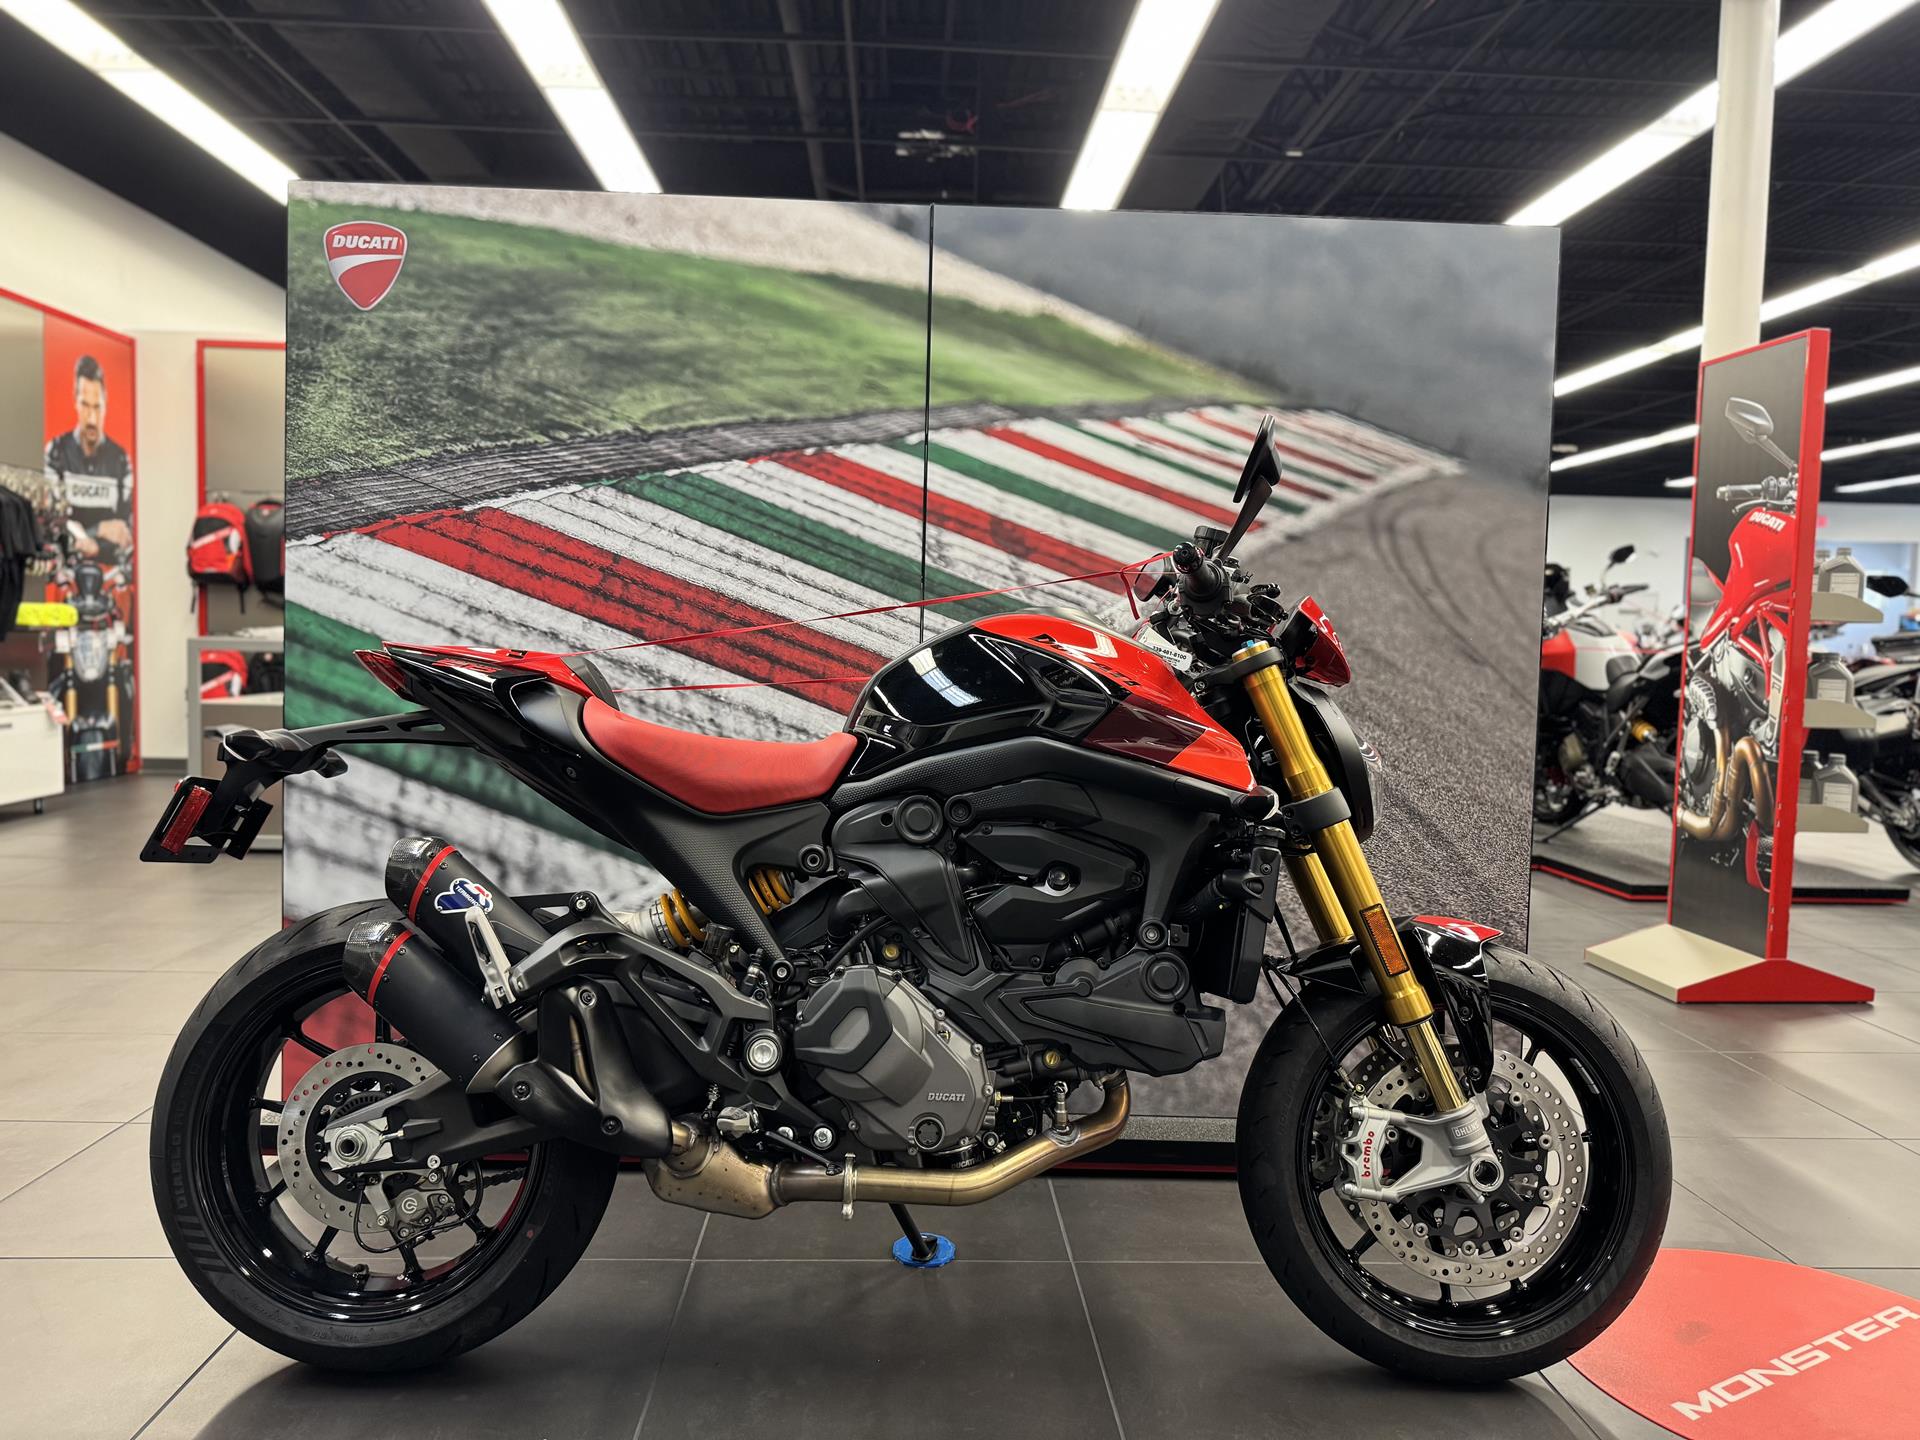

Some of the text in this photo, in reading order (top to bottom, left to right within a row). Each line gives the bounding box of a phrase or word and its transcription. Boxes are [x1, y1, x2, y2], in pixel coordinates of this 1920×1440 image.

[332, 234, 399, 250] DUCATI
[72, 484, 110, 499] DUCATI
[1749, 511, 1787, 532] DUCATI
[456, 885, 481, 907] TERMIGNO
[927, 1092, 966, 1102] DUCATI
[1361, 1130, 1375, 1178] brembo
[1671, 1305, 1920, 1421] MONSTER
